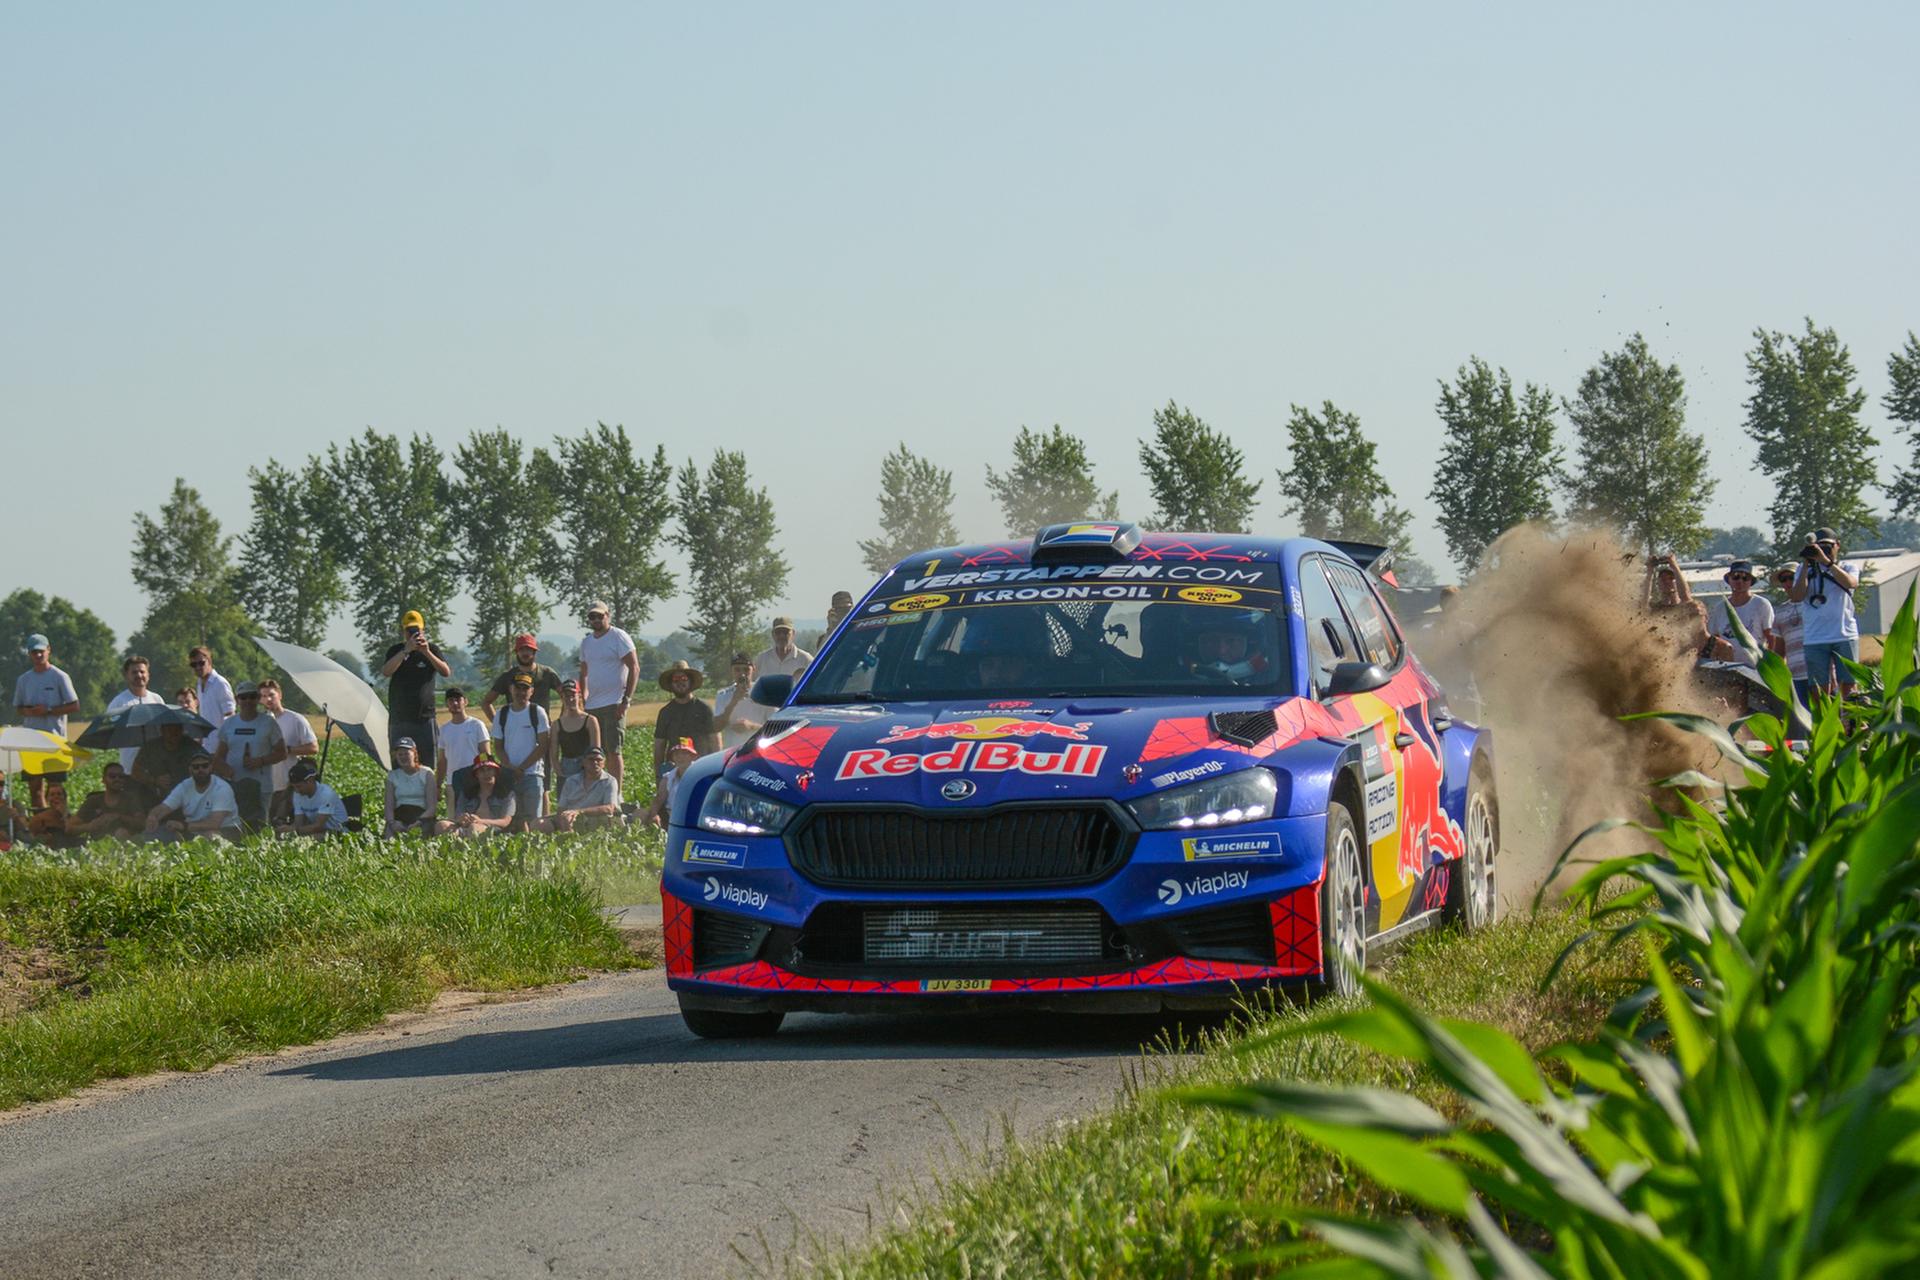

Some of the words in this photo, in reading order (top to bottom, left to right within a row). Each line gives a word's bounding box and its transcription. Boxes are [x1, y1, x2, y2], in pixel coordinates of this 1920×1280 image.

[924, 559, 941, 577] 1
[903, 564, 1264, 592] VERSTAPPEN.COM
[897, 598, 941, 608] KROON
[973, 586, 1152, 602] KROON-OIL
[1186, 591, 1233, 599] KROON
[834, 741, 976, 781] Red
[969, 741, 1108, 778] Bull
[1368, 781, 1395, 808] RACING
[1368, 807, 1396, 836] ACTION
[699, 848, 738, 860] MICHELIN
[1212, 841, 1270, 853] MICHELIN
[1184, 870, 1249, 896] viaplay
[721, 883, 769, 911] viaplay
[933, 980, 950, 990] JV
[955, 980, 986, 990] 3301
